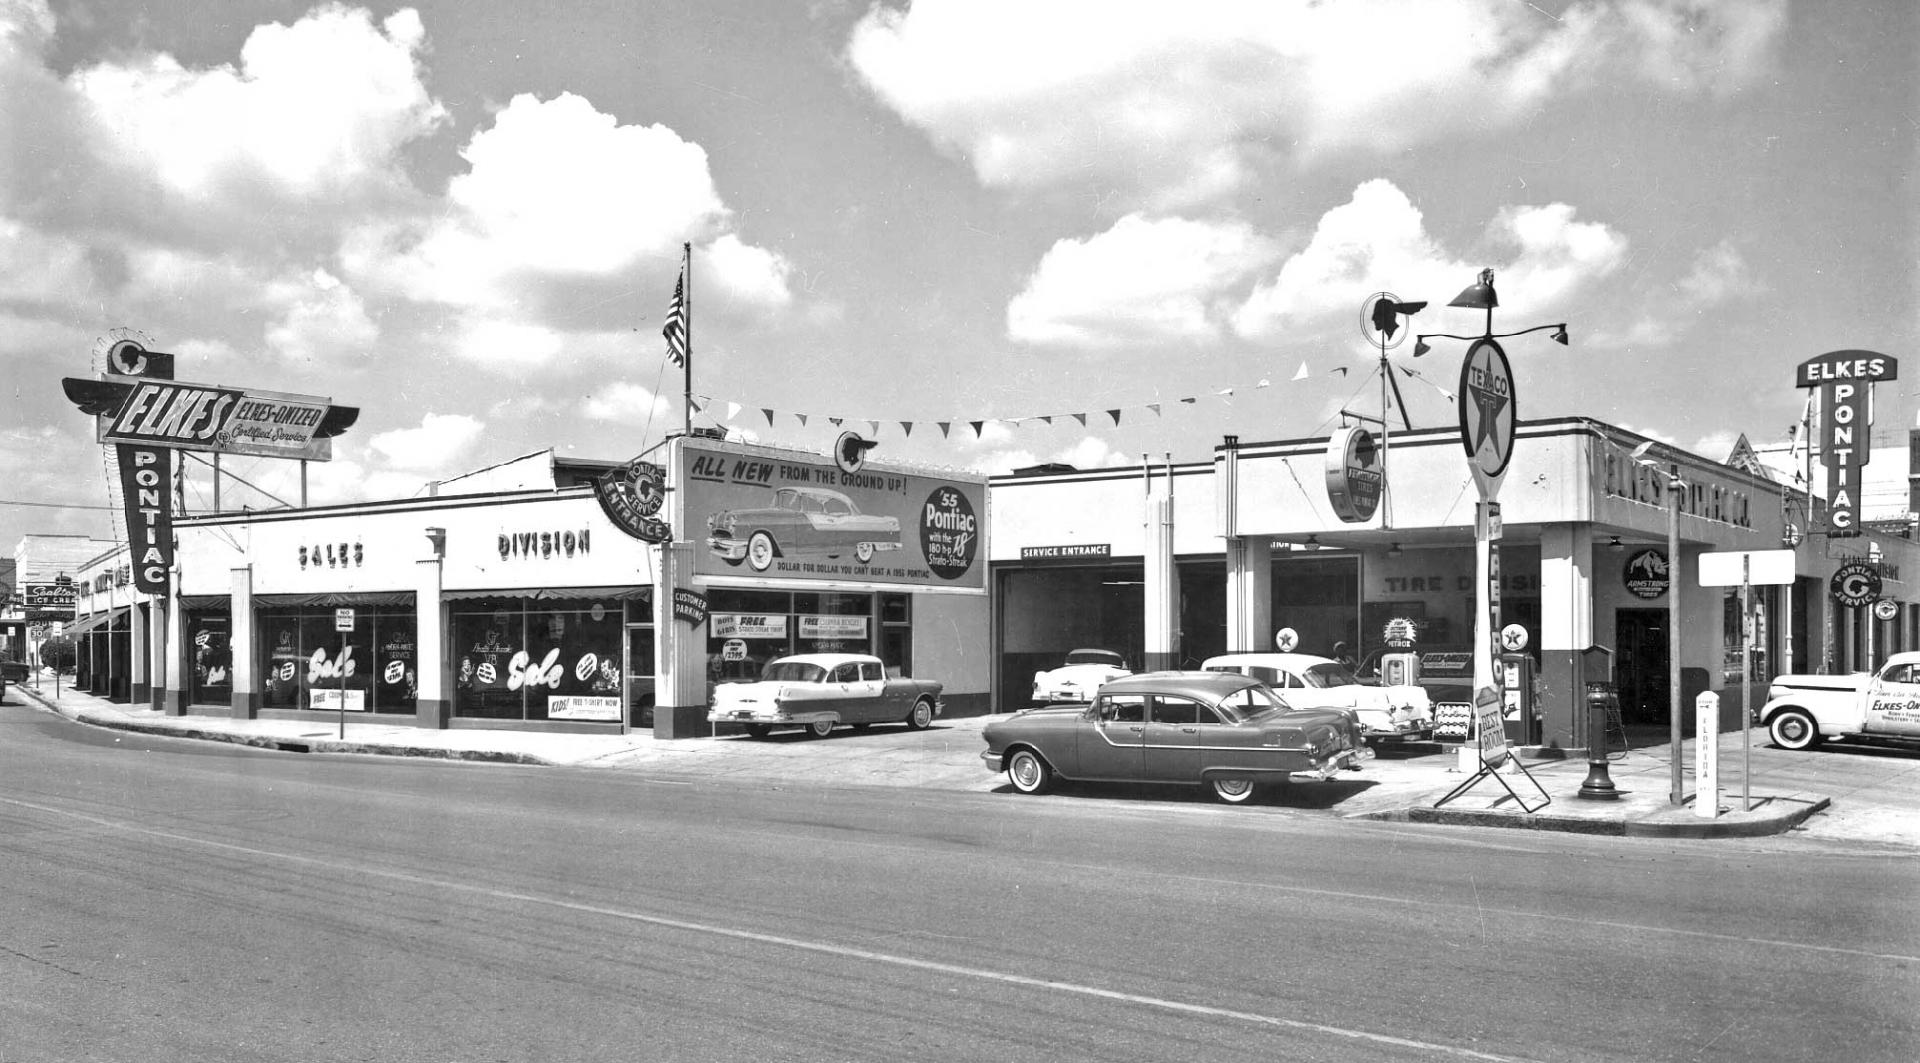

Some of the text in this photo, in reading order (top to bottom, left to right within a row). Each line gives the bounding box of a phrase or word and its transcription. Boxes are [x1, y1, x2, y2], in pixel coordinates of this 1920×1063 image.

[1807, 358, 1885, 380] ELKES
[1471, 365, 1507, 395] TEXACO
[116, 384, 233, 440] ELKES
[231, 424, 271, 442] Certified
[271, 427, 307, 443] Service
[1832, 384, 1855, 528] PONTIAC
[629, 462, 661, 483] PONTIAC
[691, 456, 907, 496] ALL NEW FROM THE GROUND UP!
[628, 496, 662, 514] SERVICE
[939, 489, 957, 507] '55
[135, 451, 166, 584] PONTIAC
[603, 483, 663, 538] ENTRANCE
[926, 503, 975, 532] Pontiac
[498, 529, 591, 561] DIVISION
[929, 533, 952, 543] with the
[298, 542, 364, 571] SALES
[929, 543, 941, 554] 180
[1023, 545, 1107, 557] SERVICE ENTRANCE
[777, 561, 800, 572] DOLLAR
[803, 563, 815, 573] FOR
[816, 564, 839, 573] DOLLAR
[841, 565, 852, 574] YOU
[870, 567, 884, 576] BEAT
[907, 569, 930, 579] PONTIAC
[1835, 566, 1878, 582] PONTIAC
[1384, 576, 1442, 592] TIRE
[675, 592, 707, 611] CUSTOMER
[675, 603, 704, 621] PARKING
[740, 617, 766, 626] FREE
[307, 645, 356, 684] Sale
[507, 647, 564, 691] Sale
[313, 692, 326, 704] FREE
[550, 698, 570, 713] KIDS!
[605, 699, 618, 707] NOW
[1481, 710, 1500, 732] REST
